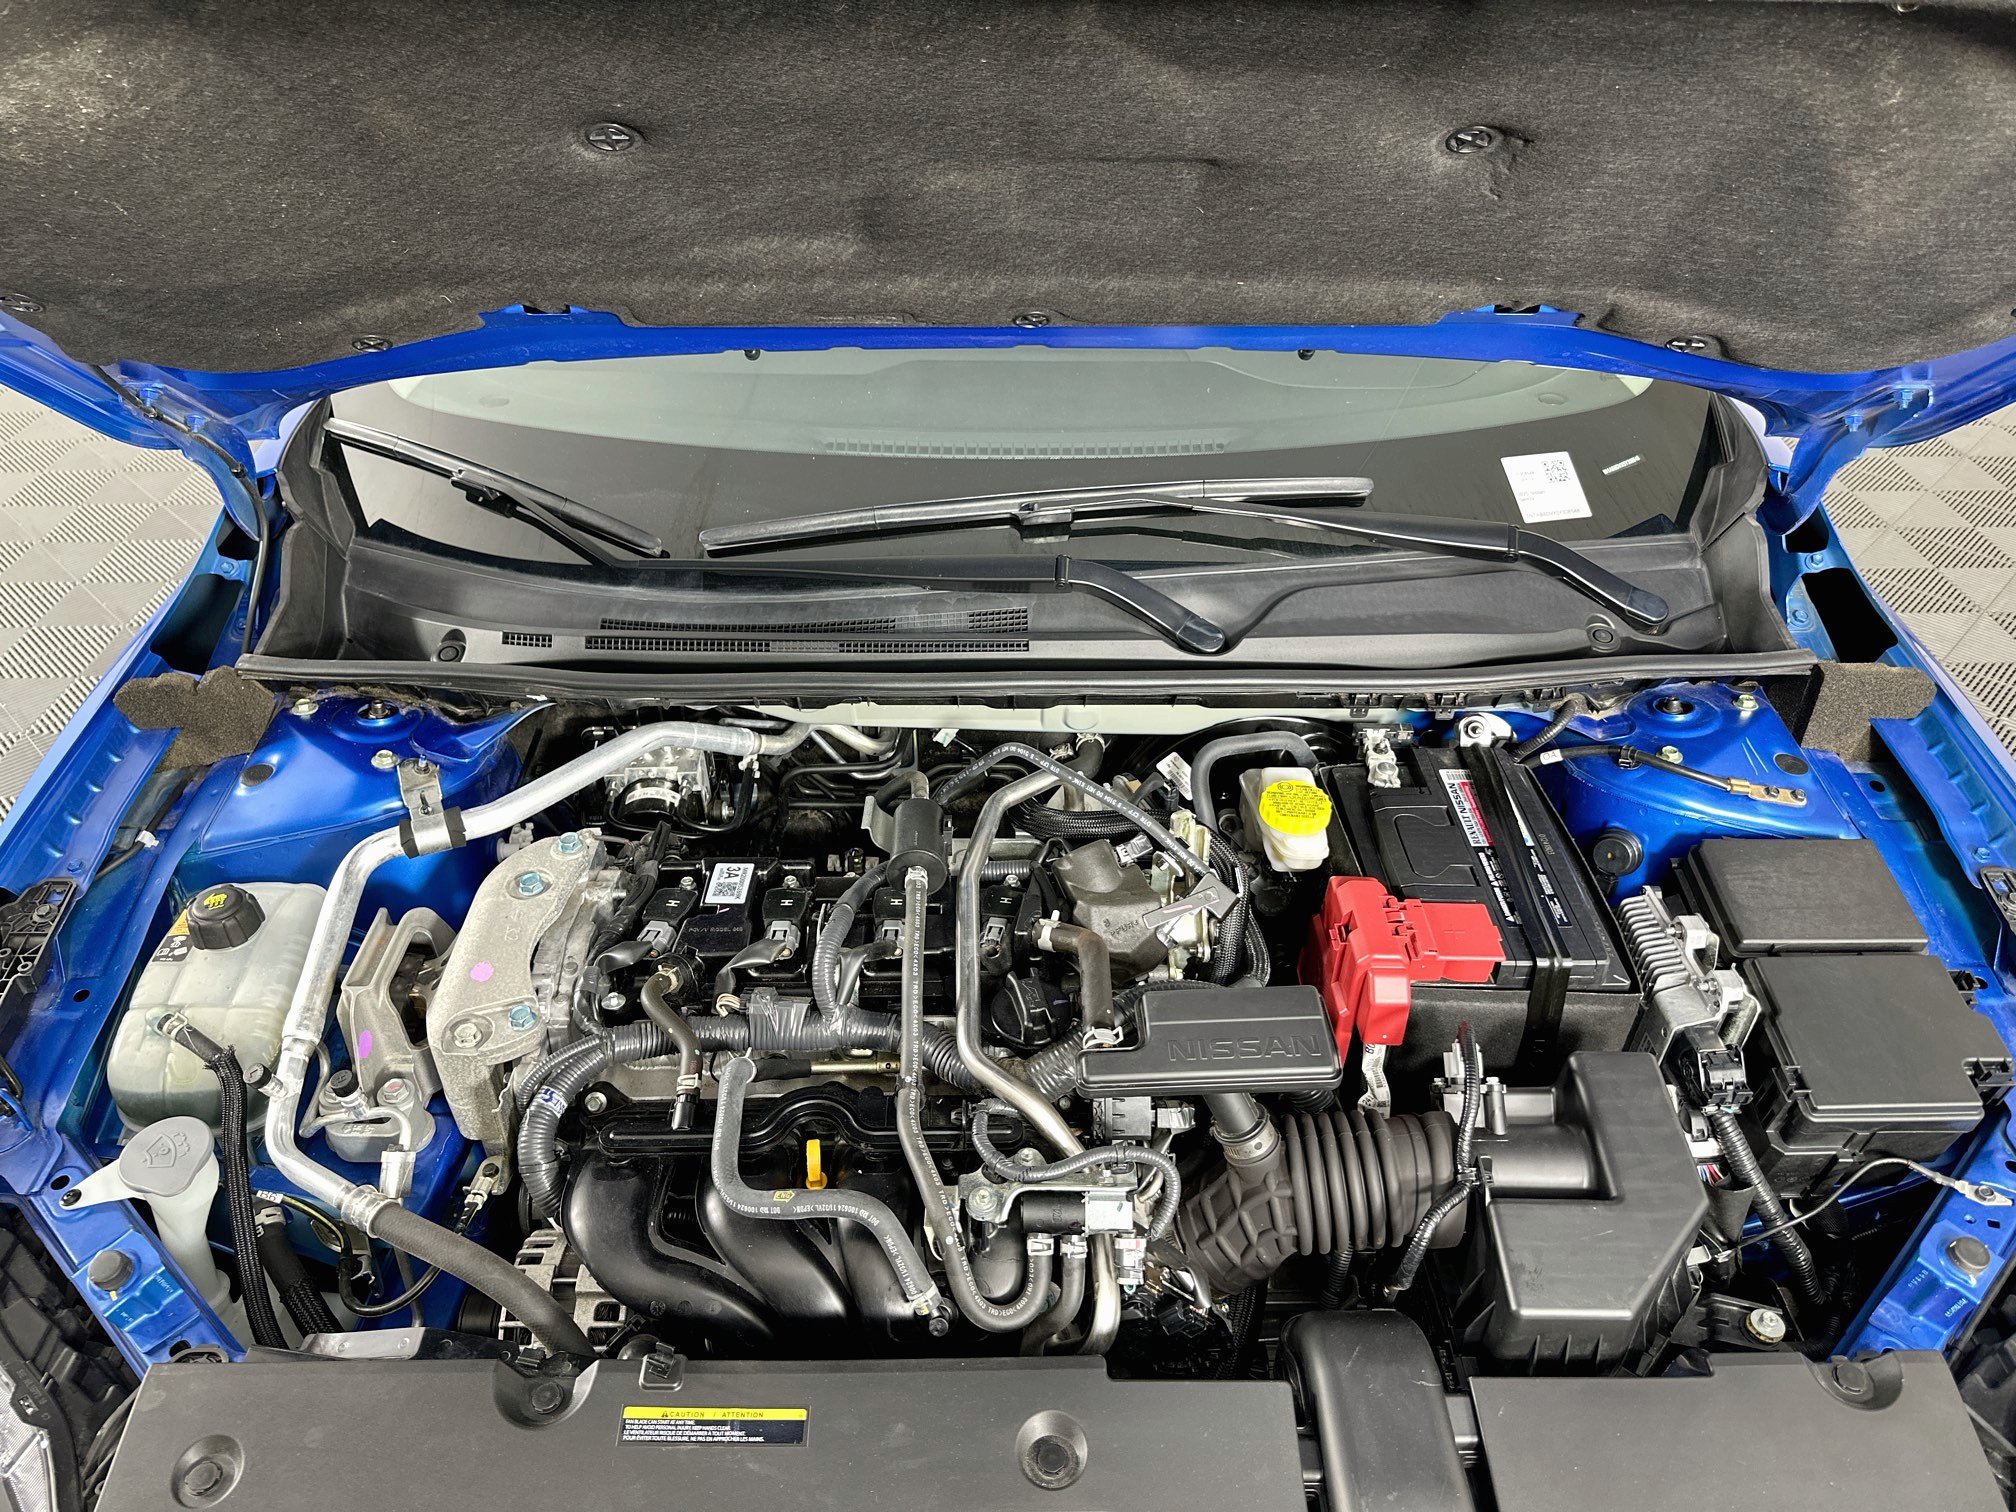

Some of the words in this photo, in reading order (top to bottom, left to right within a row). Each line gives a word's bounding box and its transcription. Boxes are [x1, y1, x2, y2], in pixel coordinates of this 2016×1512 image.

[1448, 782, 1468, 814] NISSAN
[1462, 814, 1482, 845] RENAULT
[724, 866, 741, 880] 3A
[1167, 1034, 1322, 1062] NISSAN
[669, 1411, 705, 1419] CAUTION
[721, 1411, 764, 1419] ATTENTION
